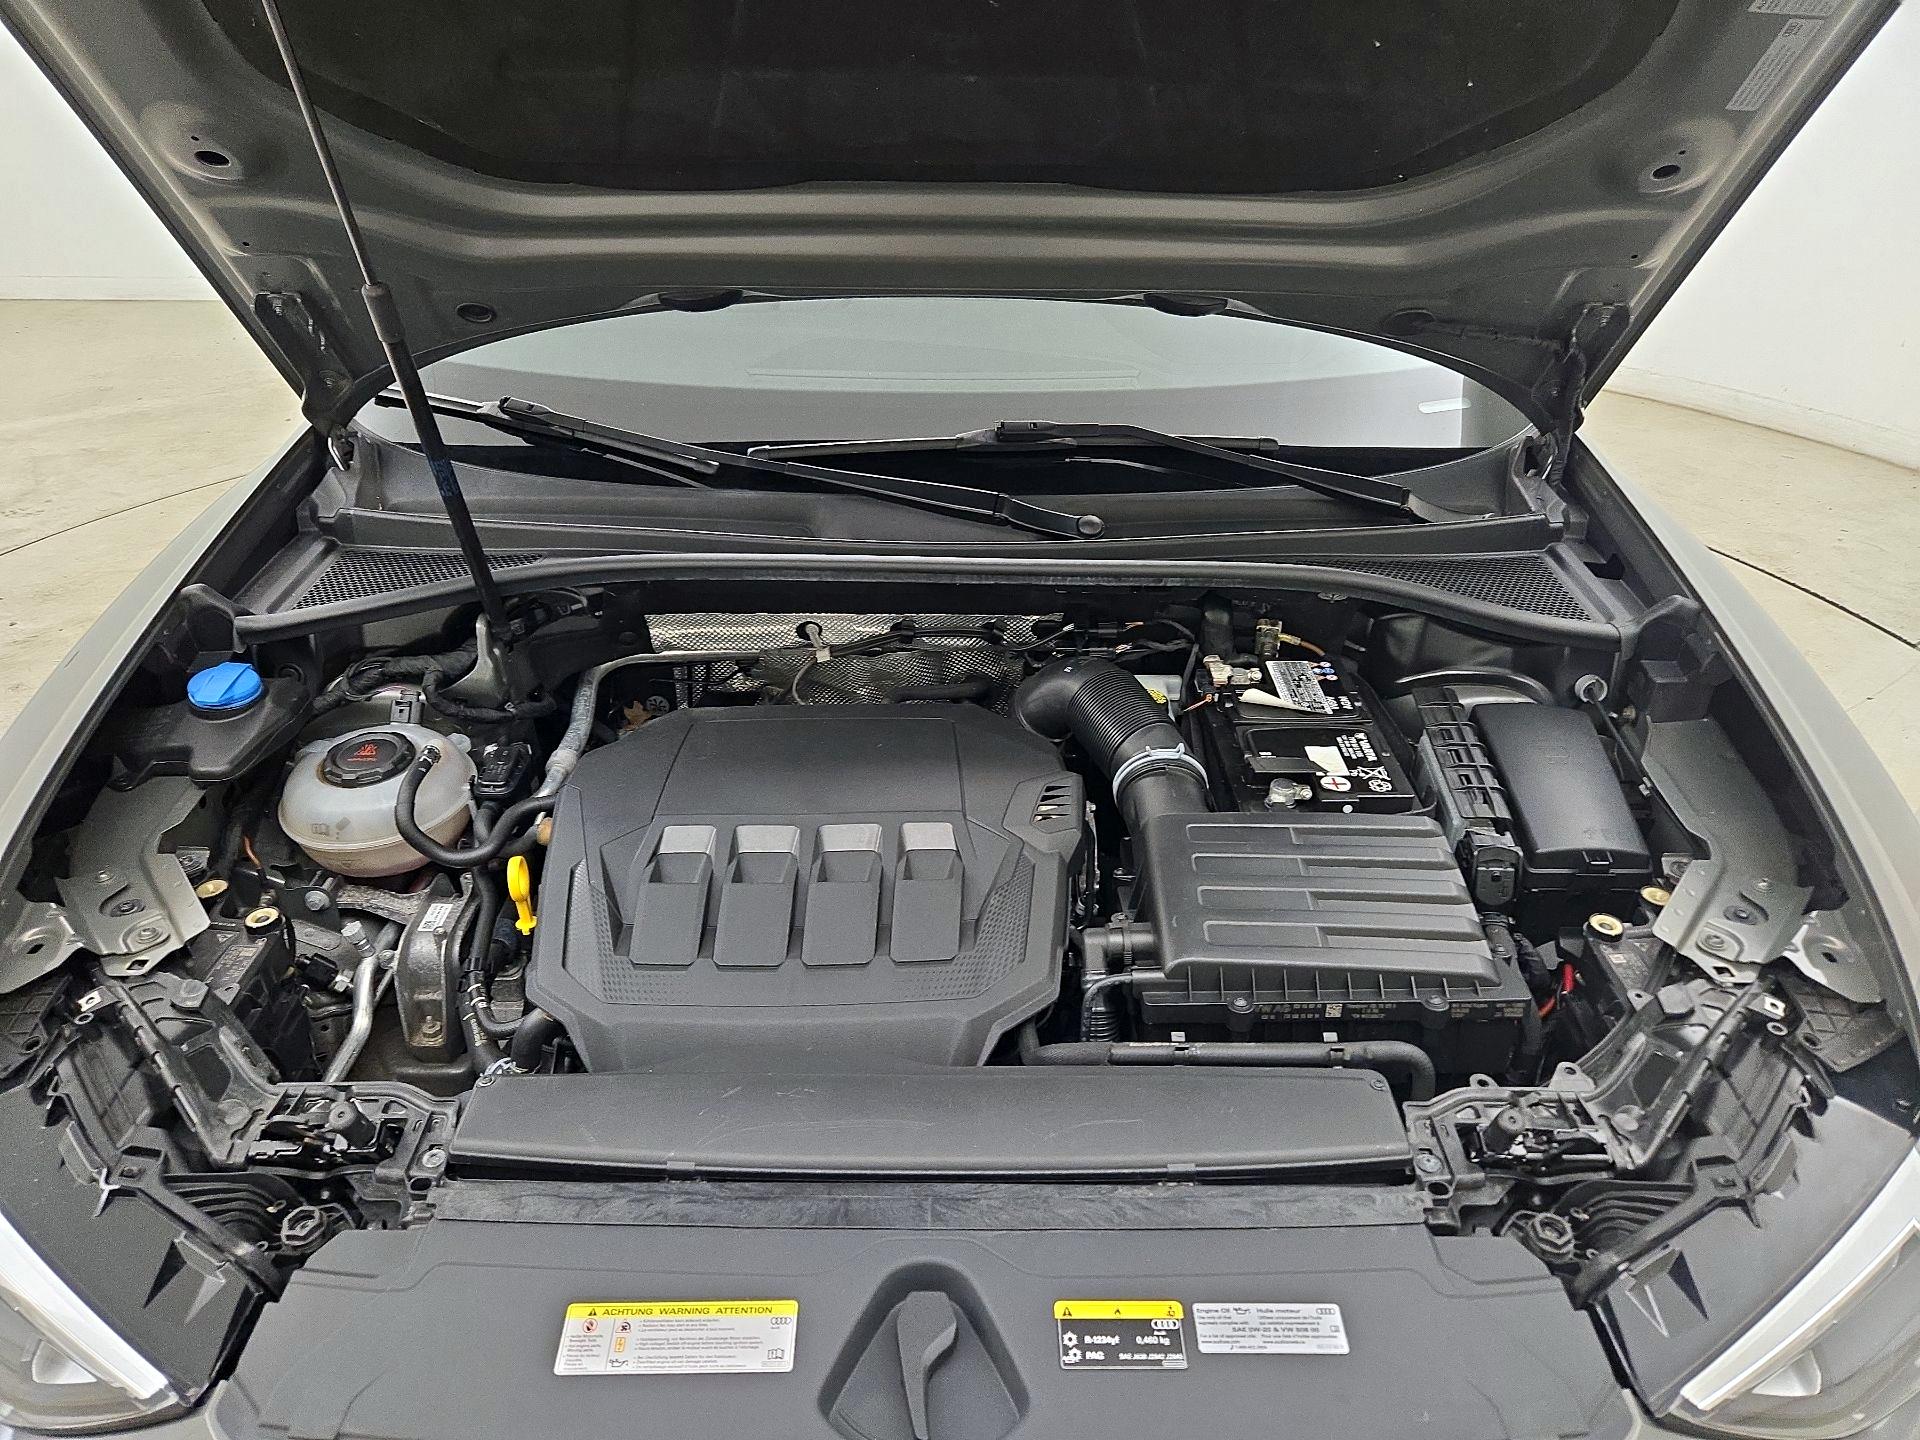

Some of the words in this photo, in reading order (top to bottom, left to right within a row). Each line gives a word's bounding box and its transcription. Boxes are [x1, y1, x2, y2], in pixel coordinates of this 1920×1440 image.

[1359, 739, 1378, 762] VARTA
[602, 1308, 654, 1316] ACHTUNG
[659, 1307, 710, 1315] WARNING
[715, 1306, 773, 1315] ATTENTION
[1160, 1336, 1171, 1346] kg
[1085, 1351, 1105, 1360] PAG
